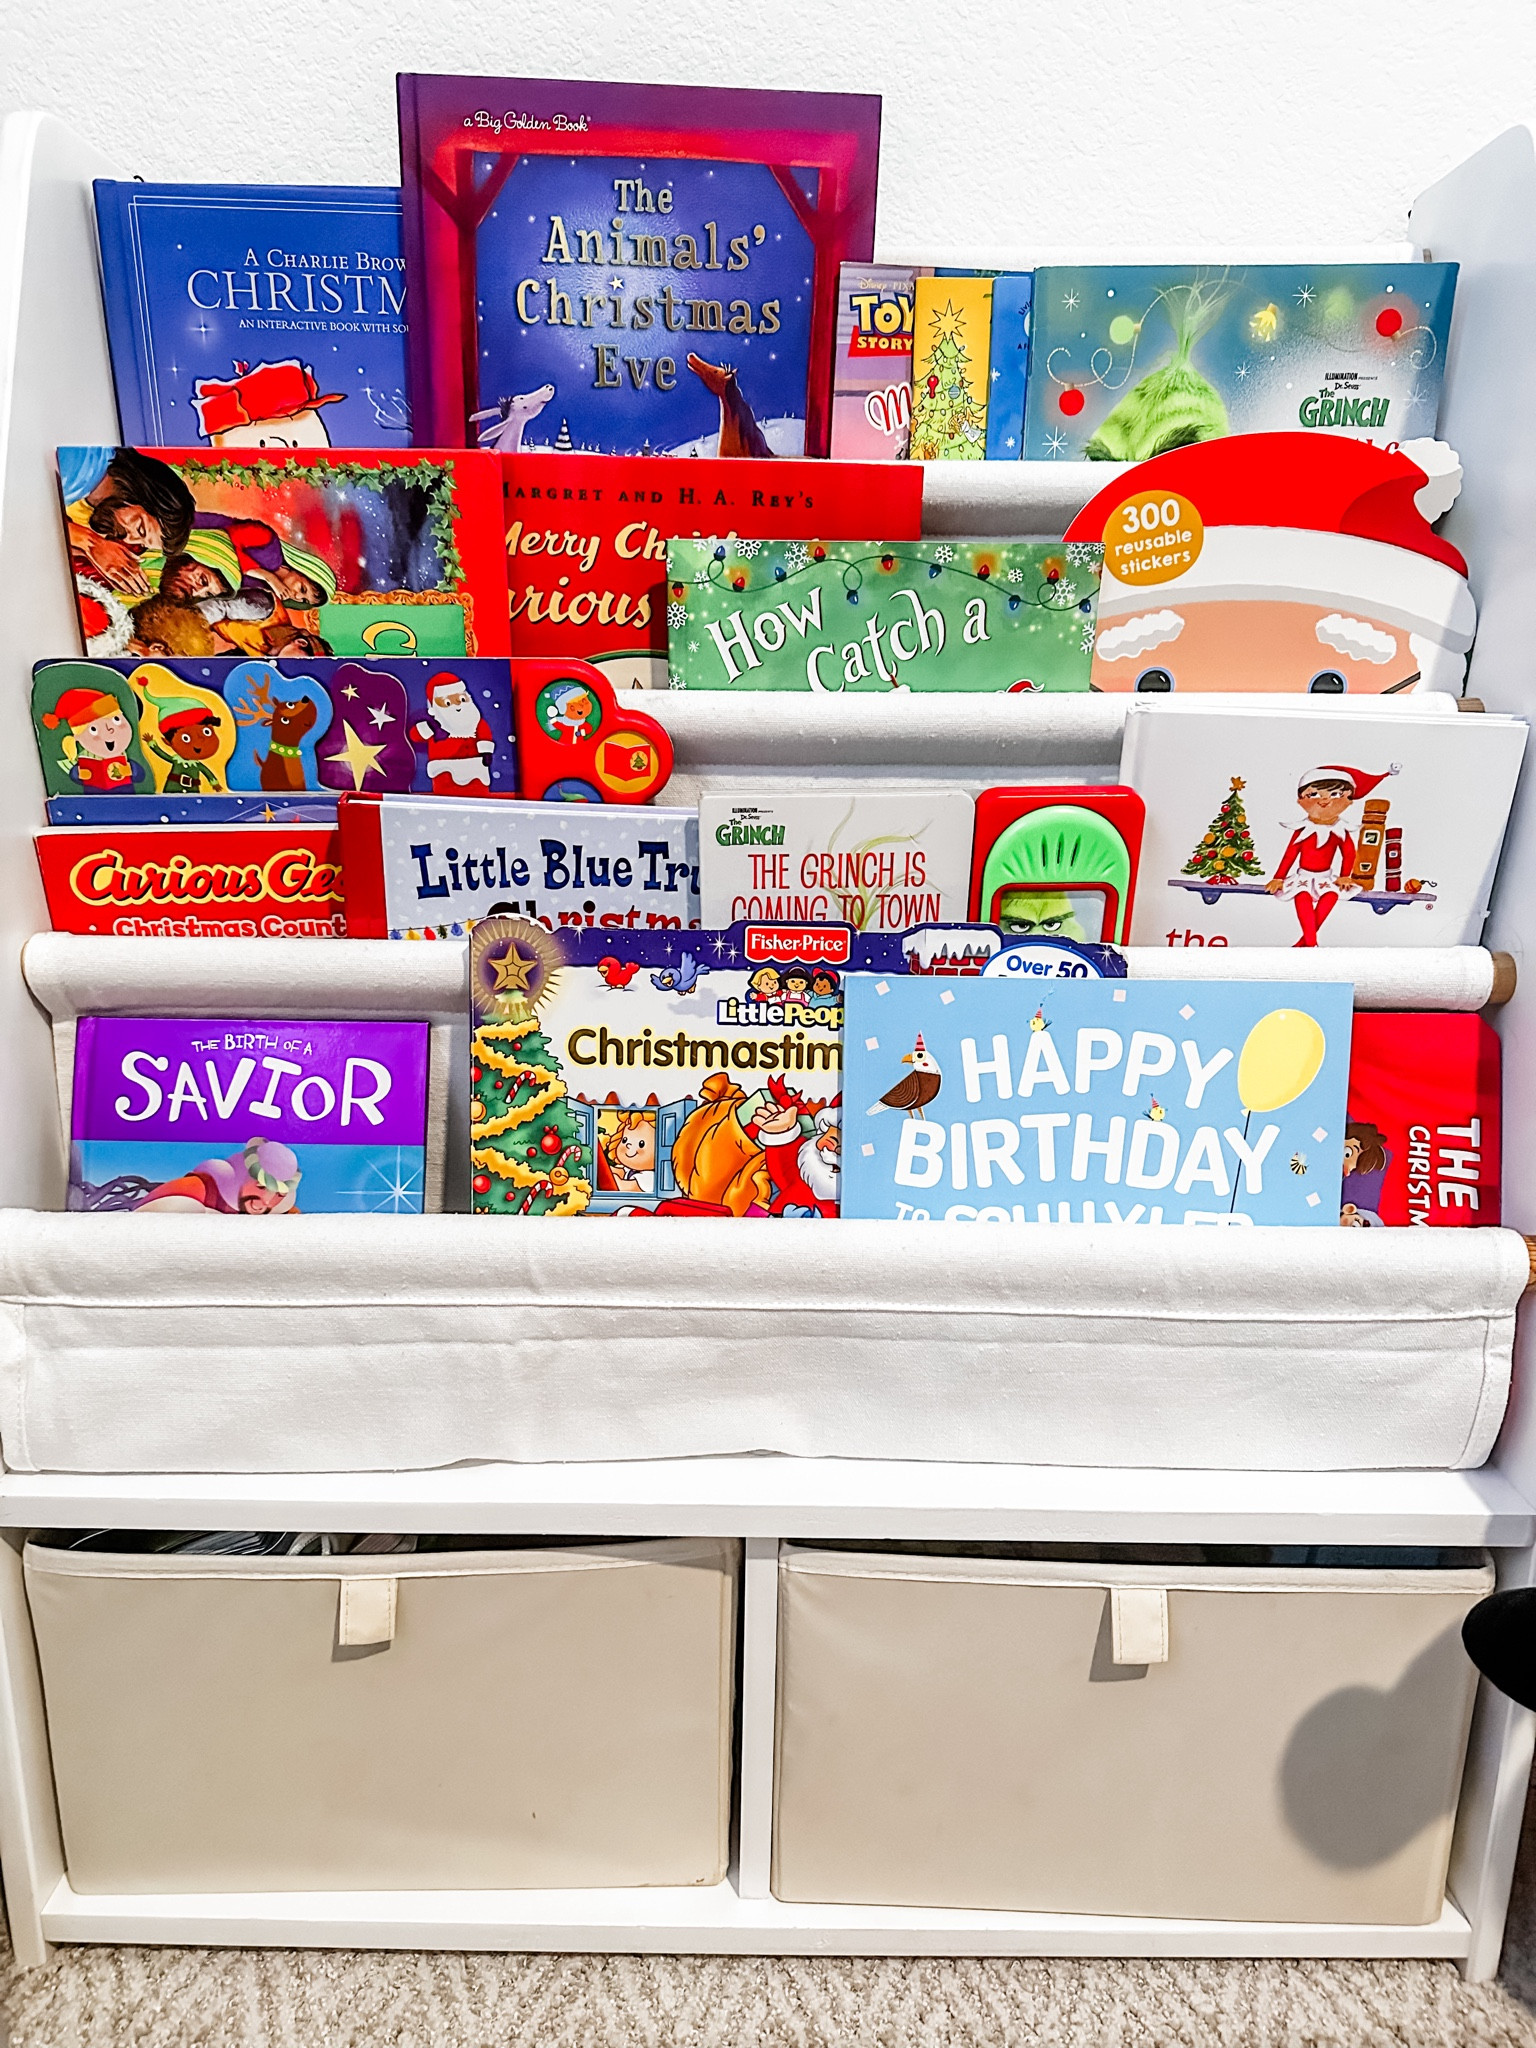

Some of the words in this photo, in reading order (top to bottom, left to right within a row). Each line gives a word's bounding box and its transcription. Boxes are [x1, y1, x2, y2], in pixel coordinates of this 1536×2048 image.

[463, 117, 474, 127] a
[474, 110, 502, 134] Big
[503, 111, 551, 129] Golden
[552, 114, 588, 131] Book
[614, 178, 673, 213] The
[243, 248, 260, 267] A
[267, 248, 349, 270] CHARLIE
[516, 276, 781, 335] Christmas
[239, 319, 255, 329] AN
[257, 319, 328, 331] INTERACTIVE
[330, 322, 360, 332] BOOK
[362, 323, 390, 333] WITH
[857, 336, 913, 350] STORY
[593, 343, 677, 391] Eve
[1319, 388, 1335, 399] The
[1299, 396, 1391, 428] GRINCH
[618, 490, 663, 504] AND
[679, 488, 702, 505] H.
[713, 489, 735, 506] A.
[1122, 498, 1180, 534] 300
[1115, 529, 1192, 557] reusable
[1120, 550, 1191, 575] stickers
[704, 587, 822, 684] How
[962, 598, 991, 643] a
[715, 824, 786, 846] GRINCH
[729, 818, 742, 826] The
[70, 849, 263, 906] Curious
[410, 842, 531, 899] Little
[540, 839, 633, 890] Blue
[748, 853, 790, 890] THE
[800, 852, 896, 889] GRINCH
[903, 851, 927, 888] IS
[113, 917, 255, 937] Christmas
[731, 895, 829, 921] COMING
[838, 894, 866, 929] TO
[876, 893, 942, 929] TOWN
[1006, 955, 1053, 976] Over
[1056, 961, 1088, 978] 50
[191, 1040, 221, 1053] THE
[224, 1033, 279, 1051] BIRTH
[283, 1040, 303, 1053] OF
[303, 1042, 313, 1056] A
[961, 1028, 1233, 1109] HAPPY
[115, 1051, 393, 1127] SAVIOR
[893, 1112, 1281, 1197] BIRTHDAY
[1437, 1118, 1481, 1210] THE
